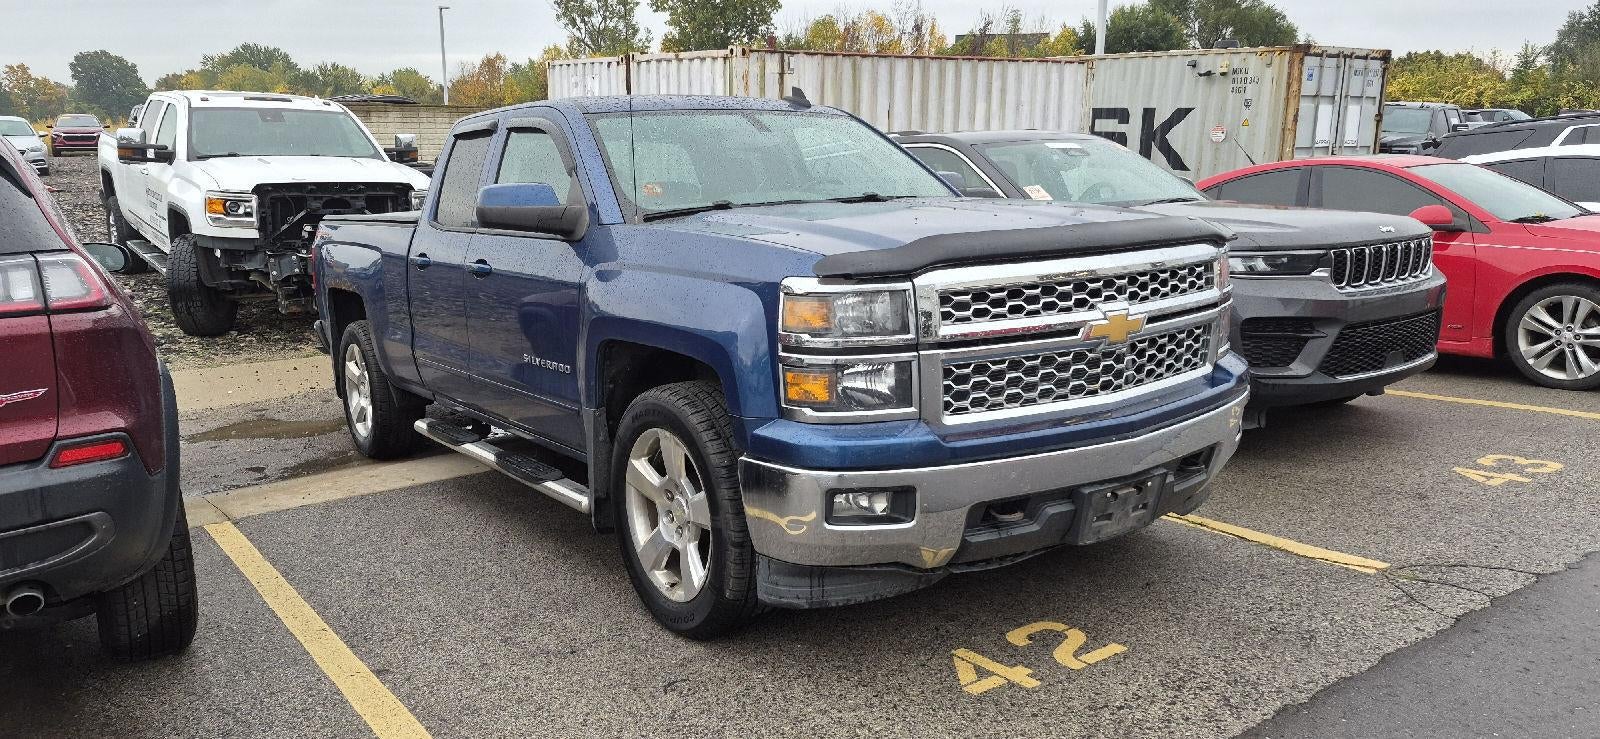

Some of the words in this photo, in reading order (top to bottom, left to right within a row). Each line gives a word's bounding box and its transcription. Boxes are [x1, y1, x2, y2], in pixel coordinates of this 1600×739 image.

[523, 353, 571, 374] SILVERADO
[1452, 454, 1564, 487] 43
[951, 620, 1128, 696] 42
